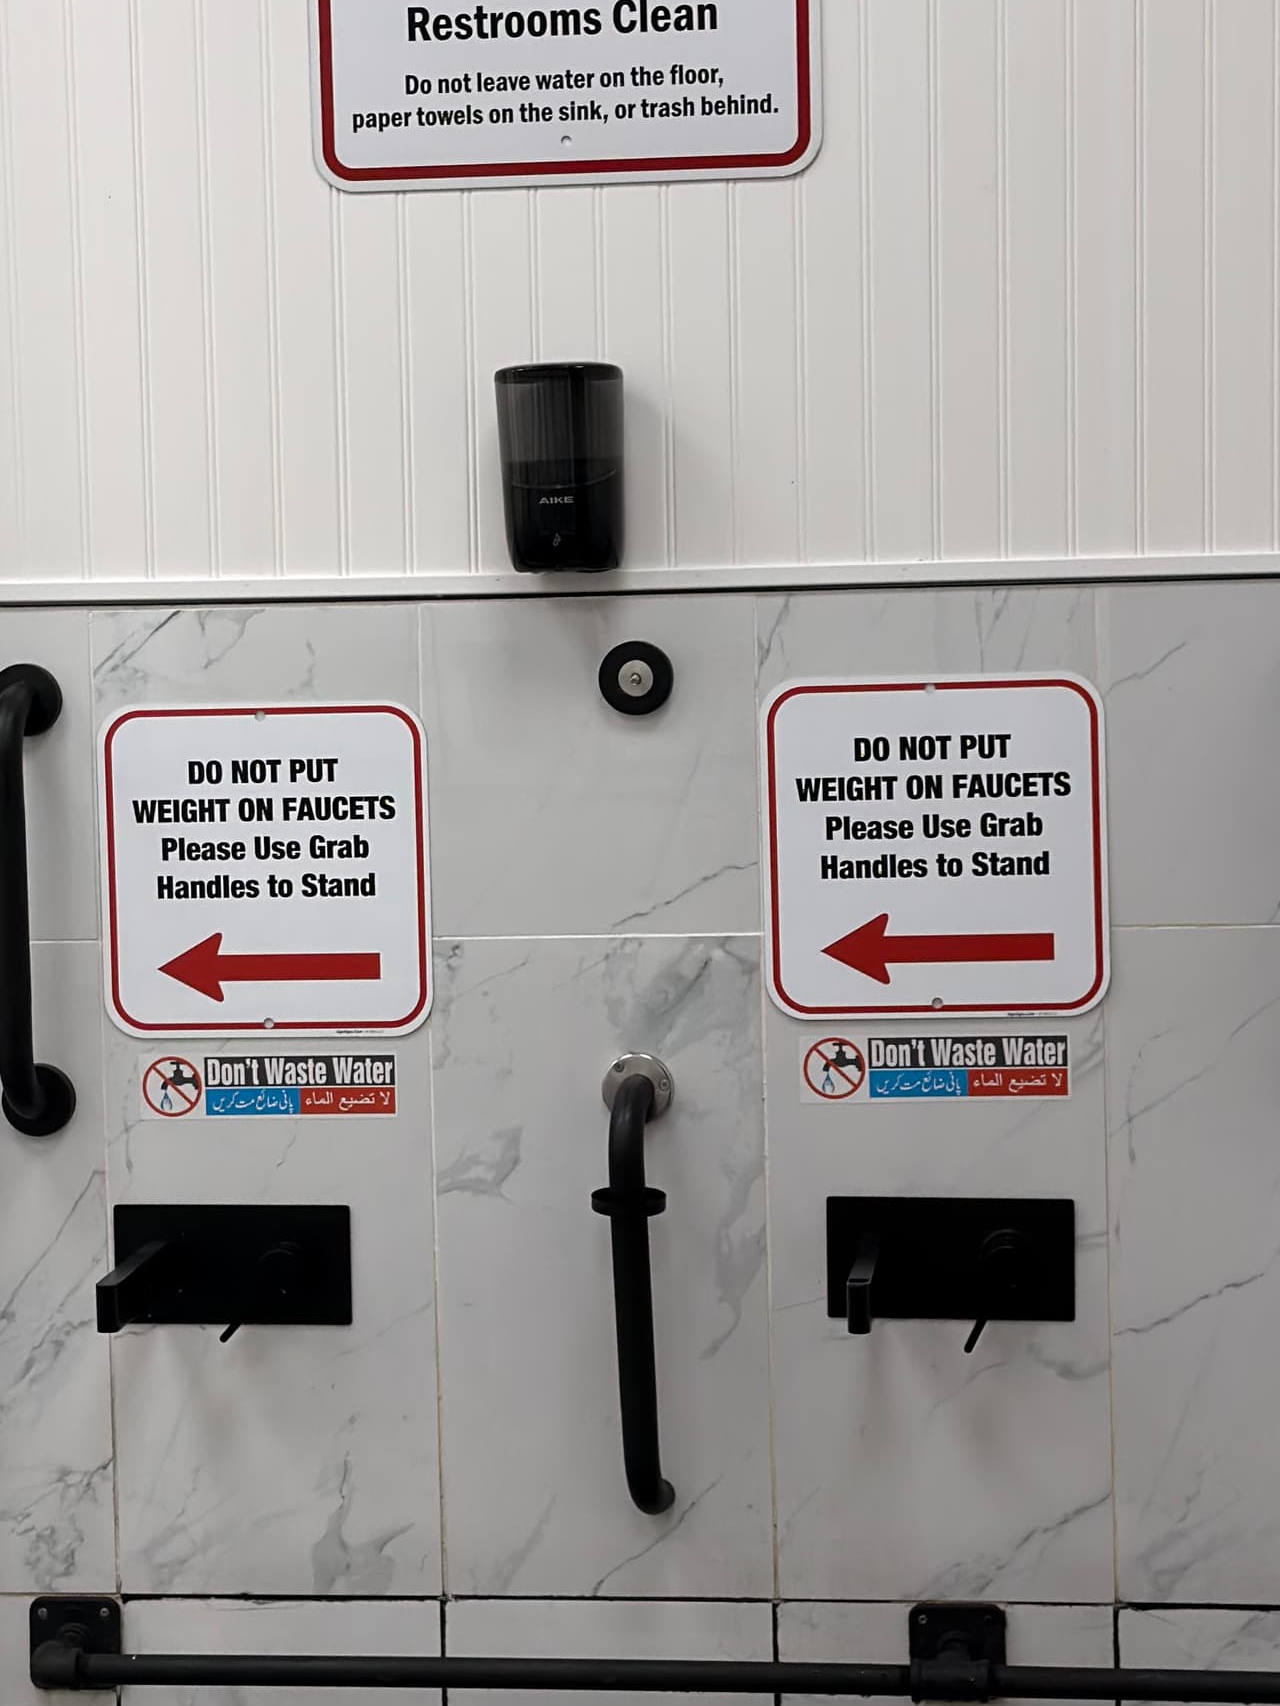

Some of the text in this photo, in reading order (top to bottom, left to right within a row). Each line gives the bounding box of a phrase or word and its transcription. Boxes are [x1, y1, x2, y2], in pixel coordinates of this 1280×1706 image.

[407, 5, 602, 42] Restrooms
[405, 63, 724, 95] Do not leave water on the floor,
[352, 93, 779, 134] paper towels on the sink, or trash behind.
[539, 495, 574, 504] AIKE
[853, 733, 1012, 762] DO NOT PUT
[188, 758, 339, 785] DO NOT PUT
[795, 771, 1072, 802] WEIGHT ON FAUCETS
[131, 795, 396, 824] WEIGHT ON FAUCETS
[825, 811, 1043, 841] Please Use Grab
[161, 834, 370, 862] Please Use Grab
[820, 850, 1050, 880] Handles to Stand
[157, 872, 376, 900] Handles to Stand
[930, 1039, 996, 1066] Waste
[1003, 1038, 1066, 1065] Water
[264, 1057, 326, 1085] Waste
[332, 1057, 392, 1084] Water
